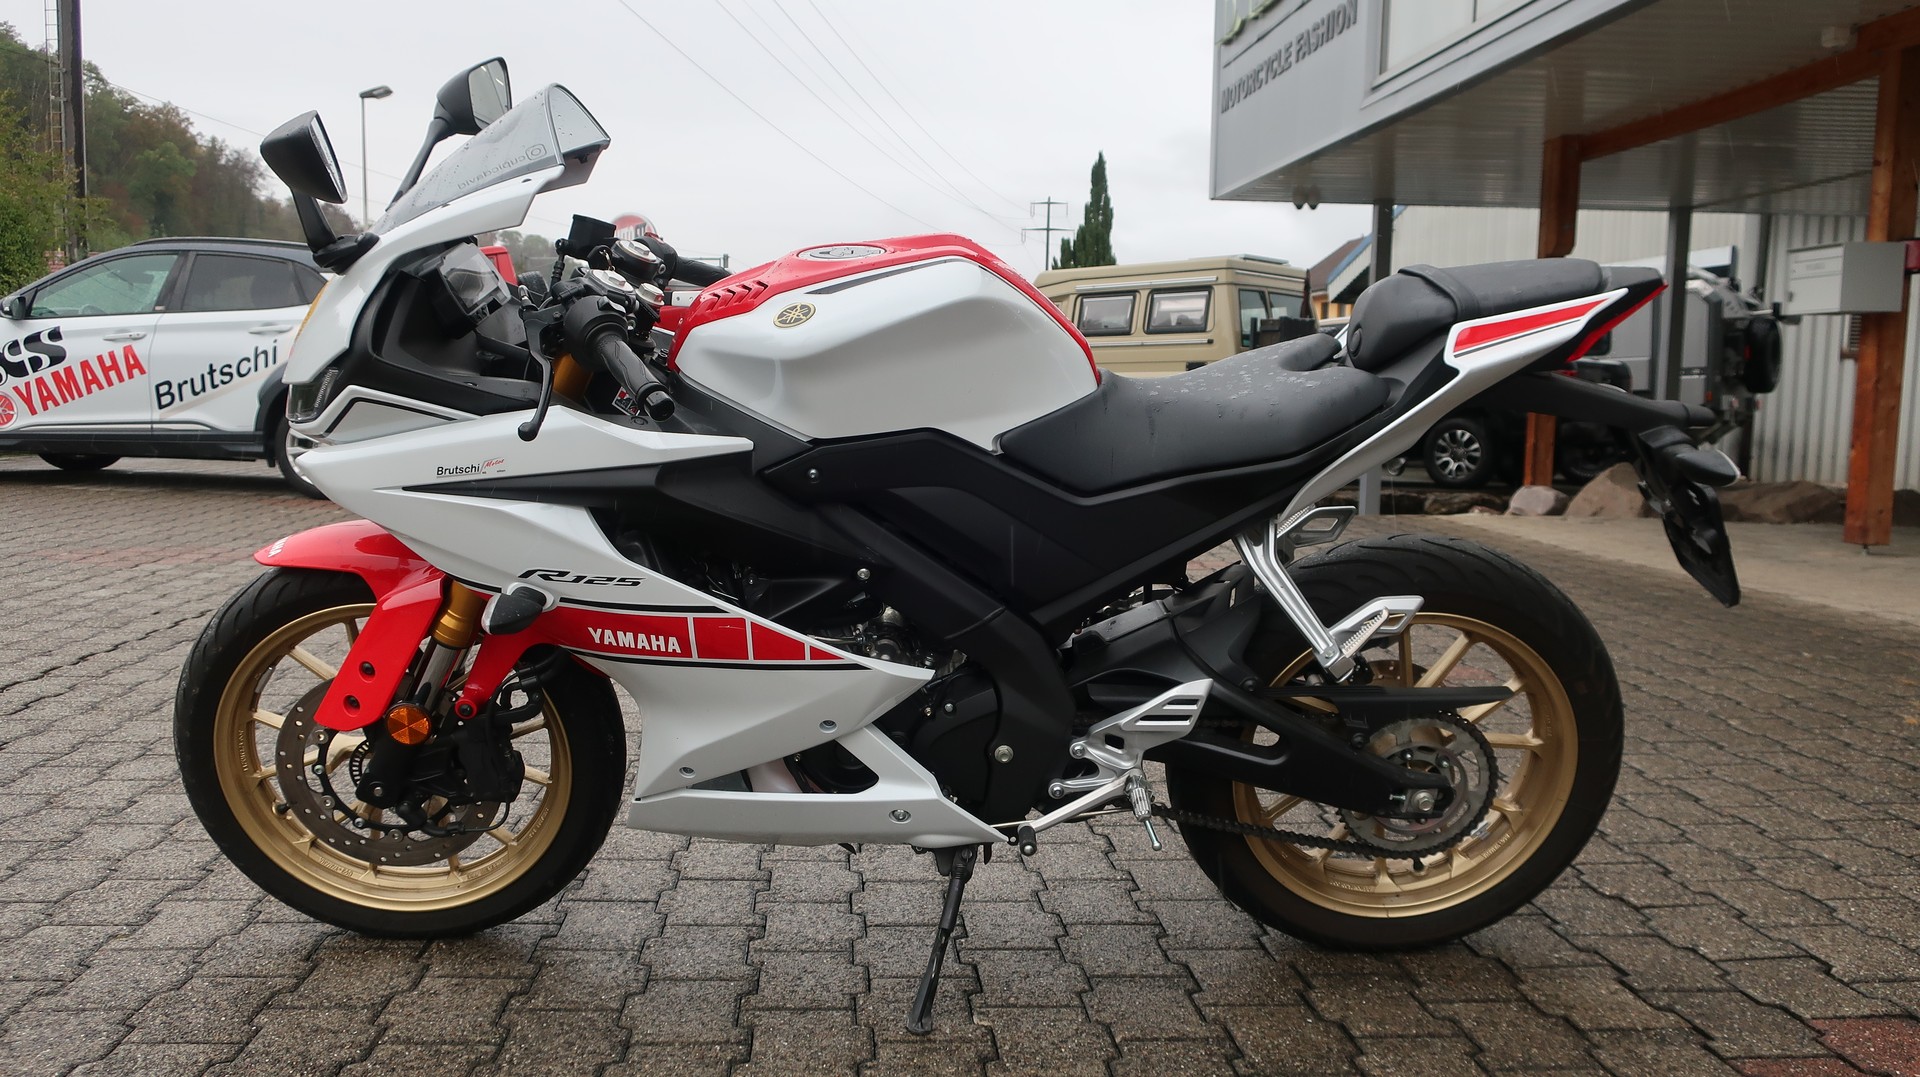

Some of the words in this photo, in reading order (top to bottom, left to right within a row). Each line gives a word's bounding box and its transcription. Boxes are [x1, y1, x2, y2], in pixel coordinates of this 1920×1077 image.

[1221, 41, 1293, 113] MOTORCYCLE
[1295, 0, 1358, 63] FASHION
[12, 344, 146, 416] YAMAHA
[155, 339, 278, 410] Brutschi
[436, 464, 480, 476] Brutschi
[588, 627, 682, 653] YAMAHA
